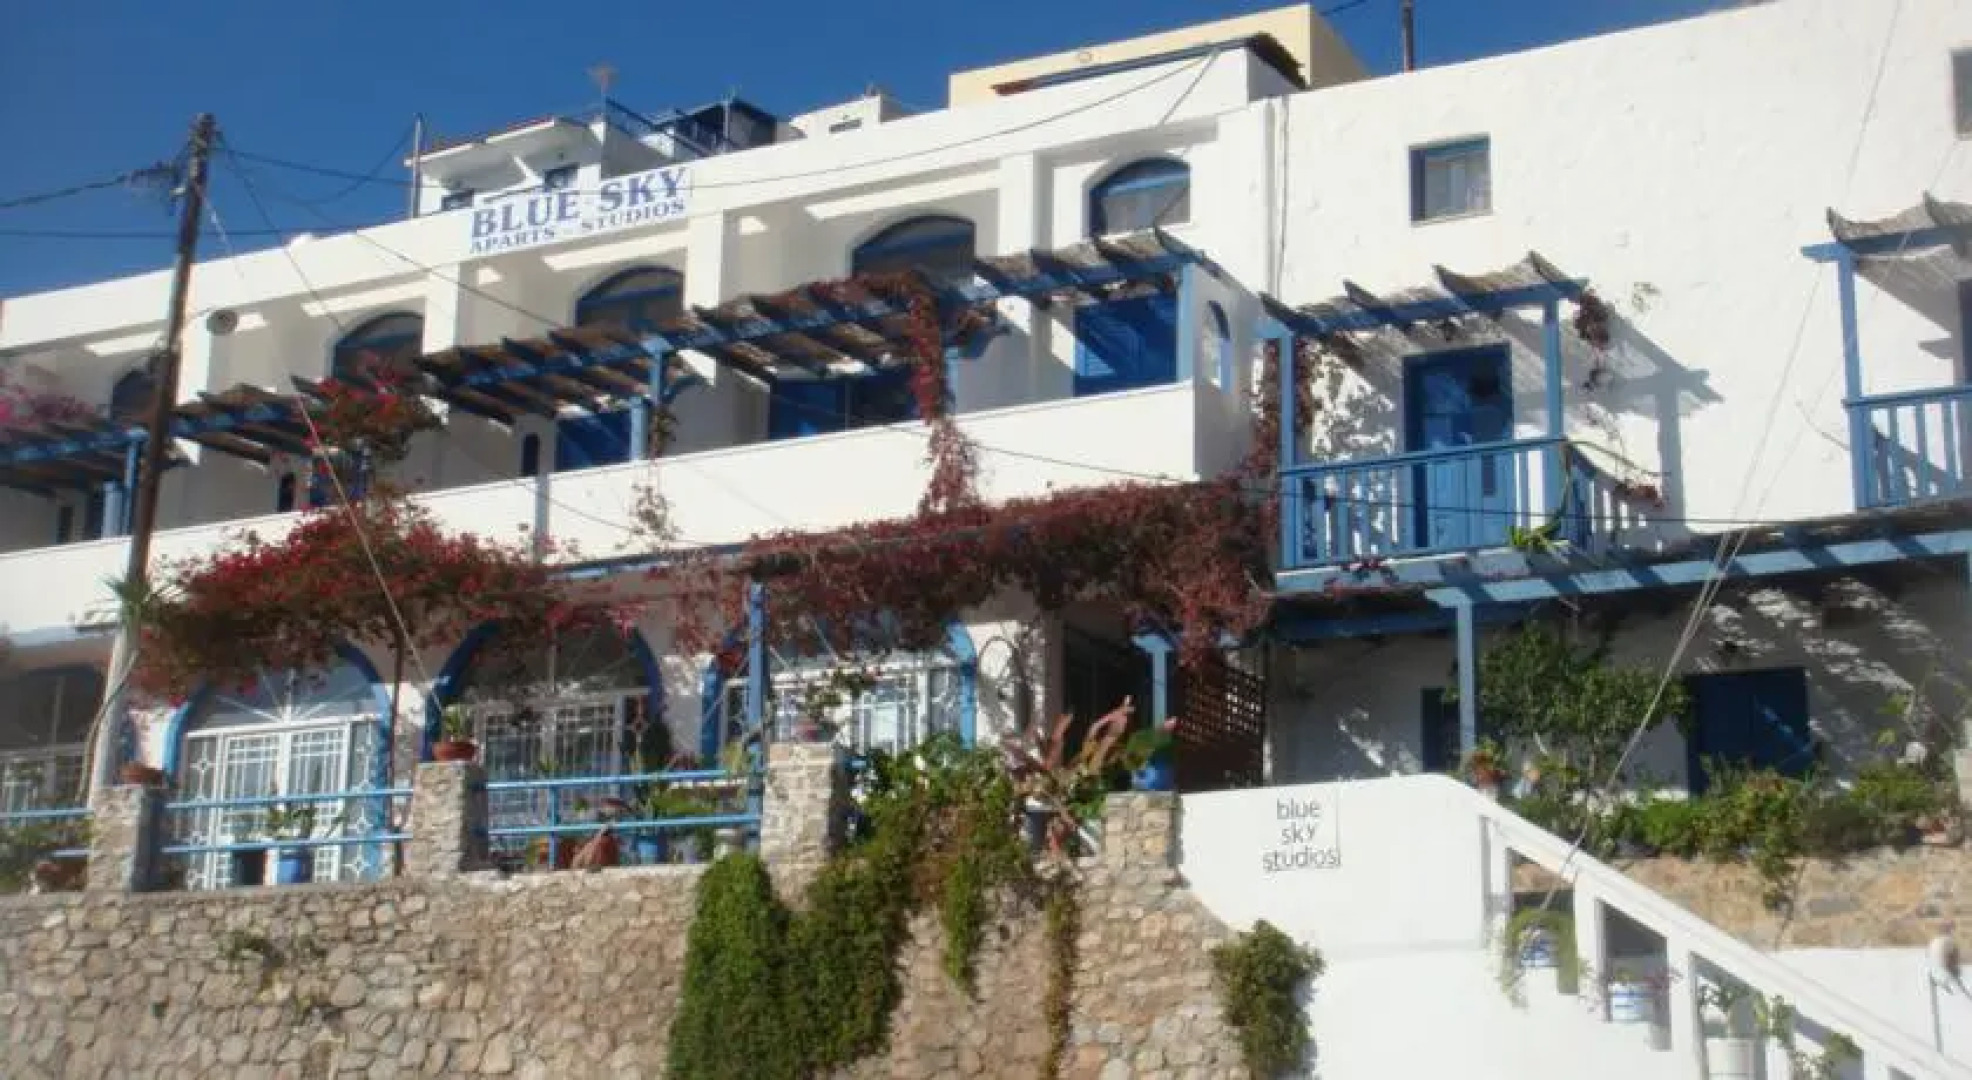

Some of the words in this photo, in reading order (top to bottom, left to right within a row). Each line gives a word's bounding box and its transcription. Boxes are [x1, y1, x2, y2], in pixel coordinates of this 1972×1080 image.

[472, 190, 580, 238] BLUE
[600, 166, 687, 212] SKY
[470, 227, 555, 254] APARTS
[582, 199, 685, 231] STUDIOS
[1277, 797, 1321, 820] blue
[1282, 821, 1316, 845] sky
[1262, 844, 1337, 871] studios
